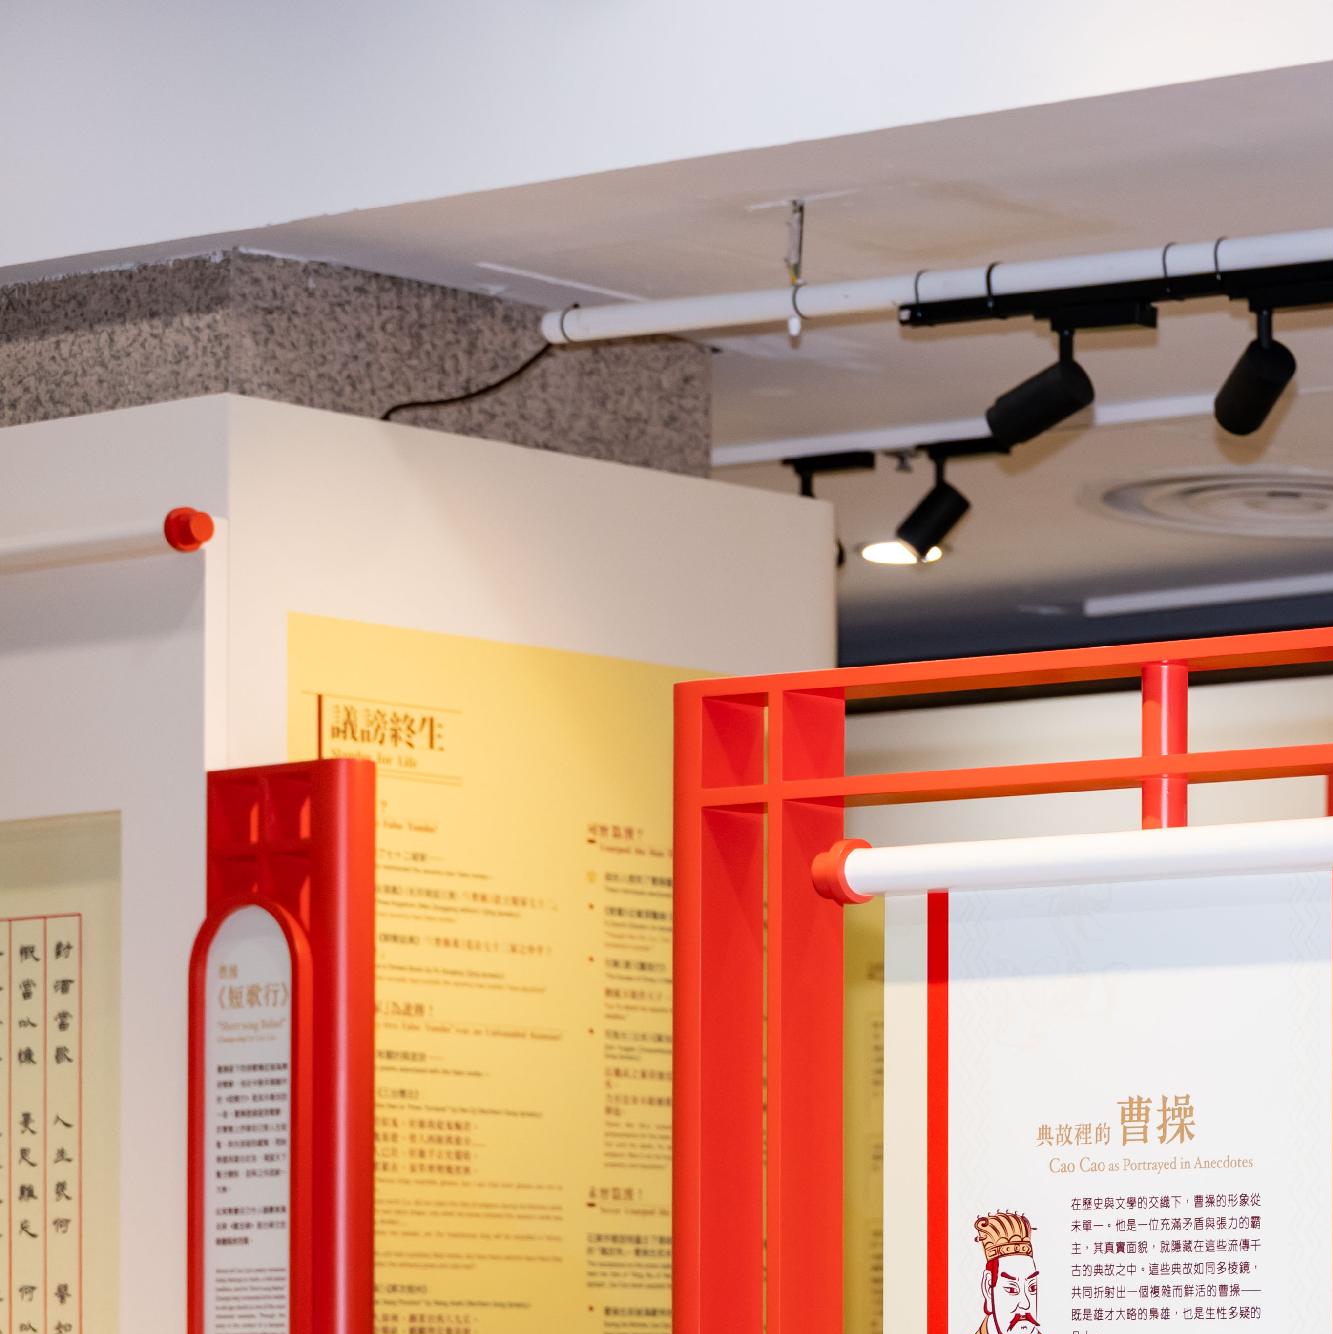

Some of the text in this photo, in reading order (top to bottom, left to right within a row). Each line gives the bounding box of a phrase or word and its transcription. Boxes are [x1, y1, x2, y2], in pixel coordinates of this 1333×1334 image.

[1036, 1094, 1196, 1147] 典故裡的 曹操
[1049, 1154, 1254, 1175] Cao Cao as Portrayed in Anecdotes
